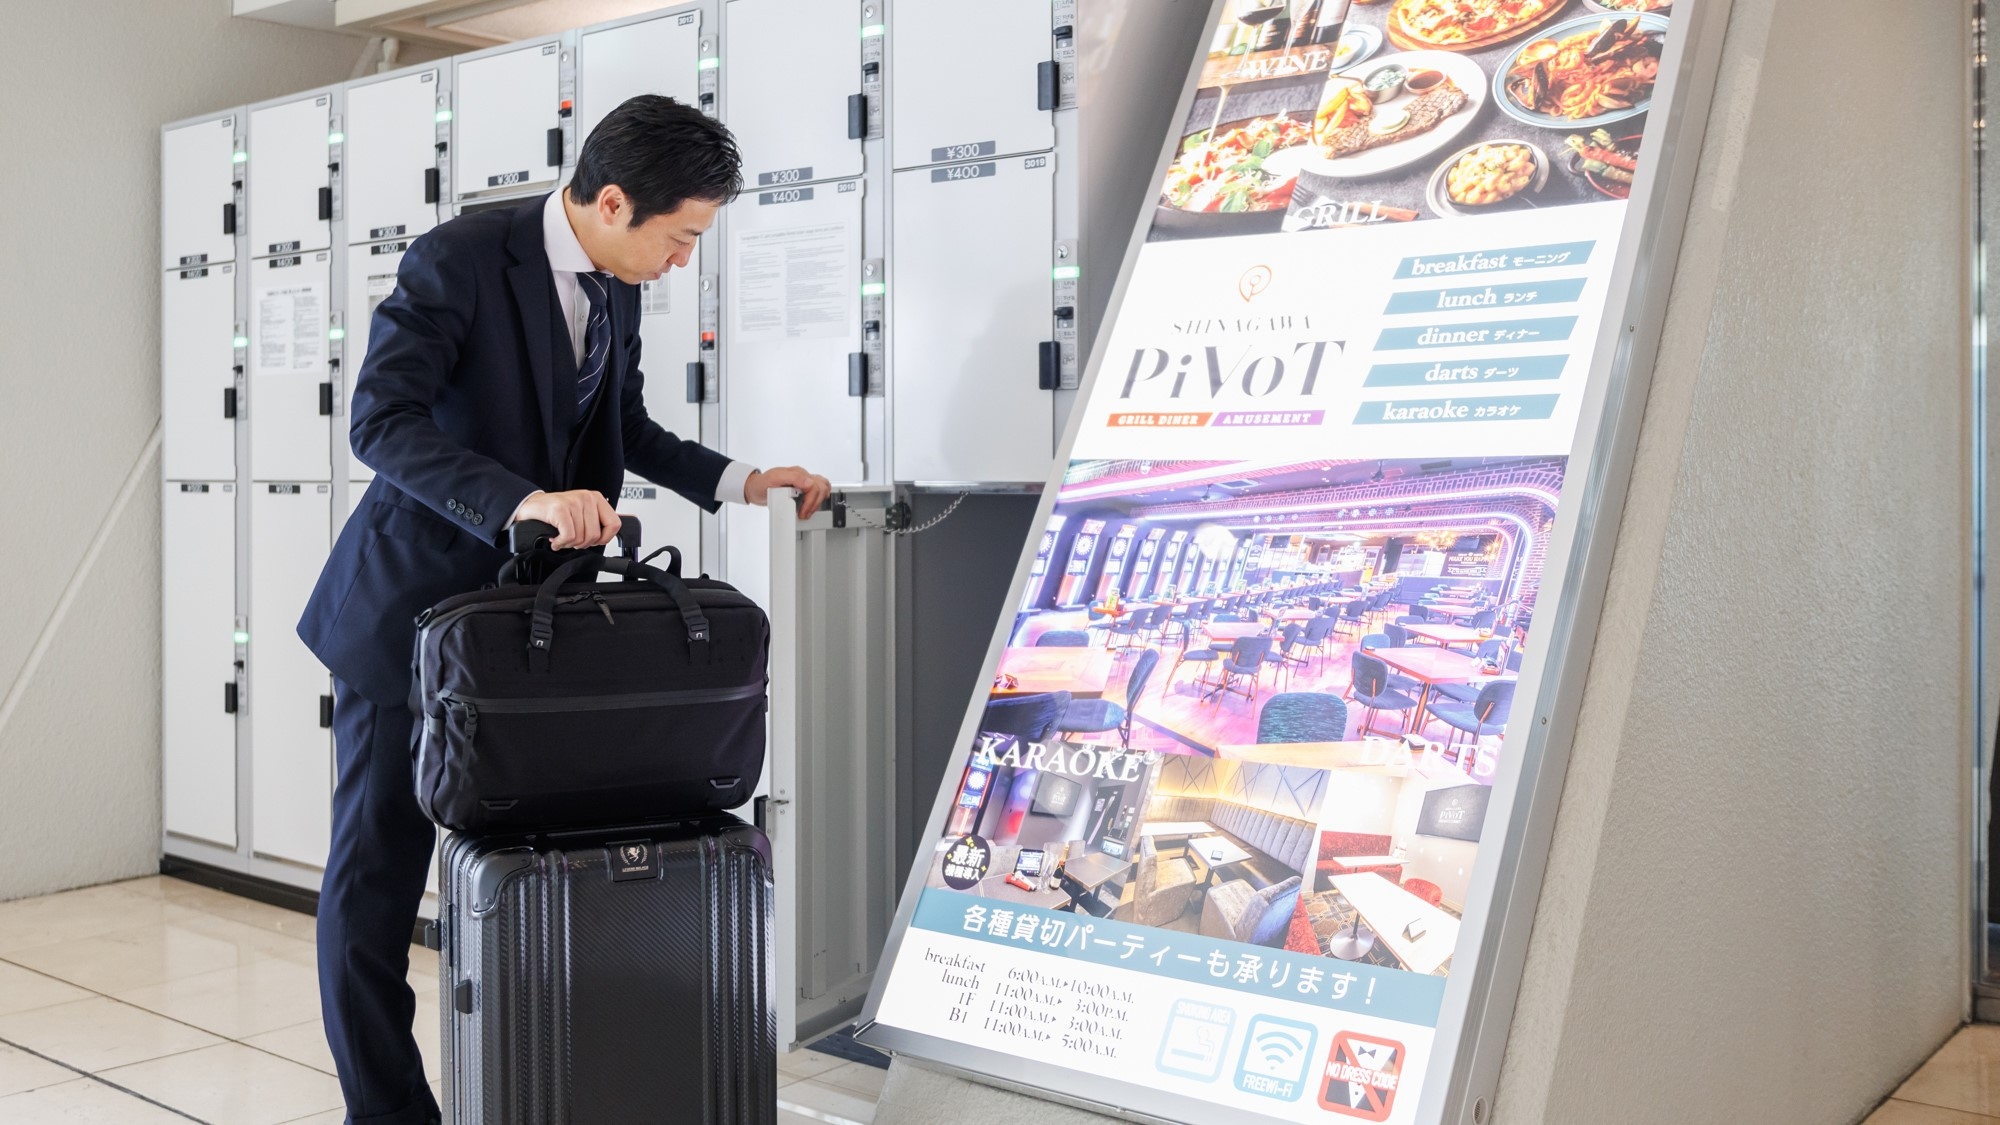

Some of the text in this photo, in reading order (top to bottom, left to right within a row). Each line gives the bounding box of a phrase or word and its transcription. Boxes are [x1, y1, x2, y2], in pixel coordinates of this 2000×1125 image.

[1247, 50, 1330, 78] WINE
[947, 144, 980, 159] ¥300
[1025, 158, 1045, 168] 3019
[497, 172, 519, 184] ¥300
[771, 170, 800, 182] ¥300
[947, 166, 980, 180] ¥400
[772, 190, 800, 203] ¥400
[1293, 200, 1388, 228] GRILL
[378, 226, 397, 237] ¥300
[379, 243, 398, 253] ¥400
[1411, 251, 1571, 275] breakfast モーニング
[1436, 288, 1538, 308] lunch ランチ
[1171, 315, 1311, 334] SHINAGAWA
[1417, 328, 1540, 345] dinner ディナー
[1119, 340, 1347, 399] PiVoT
[1424, 363, 1519, 382] darts ダーツ
[1118, 415, 1199, 425] GRILL DINER
[1222, 413, 1312, 425] AMUSEMENT
[1382, 400, 1522, 421] karaoke カラオケ
[975, 736, 1143, 783] KARAOKE
[1360, 735, 1498, 777] DARTS
[951, 844, 986, 868] 最新
[924, 947, 986, 973] breakfast
[941, 969, 980, 990] lunch
[958, 992, 977, 1006] 1F
[948, 1007, 968, 1024] B1
[1326, 1062, 1399, 1091] NO DRESS CODE
